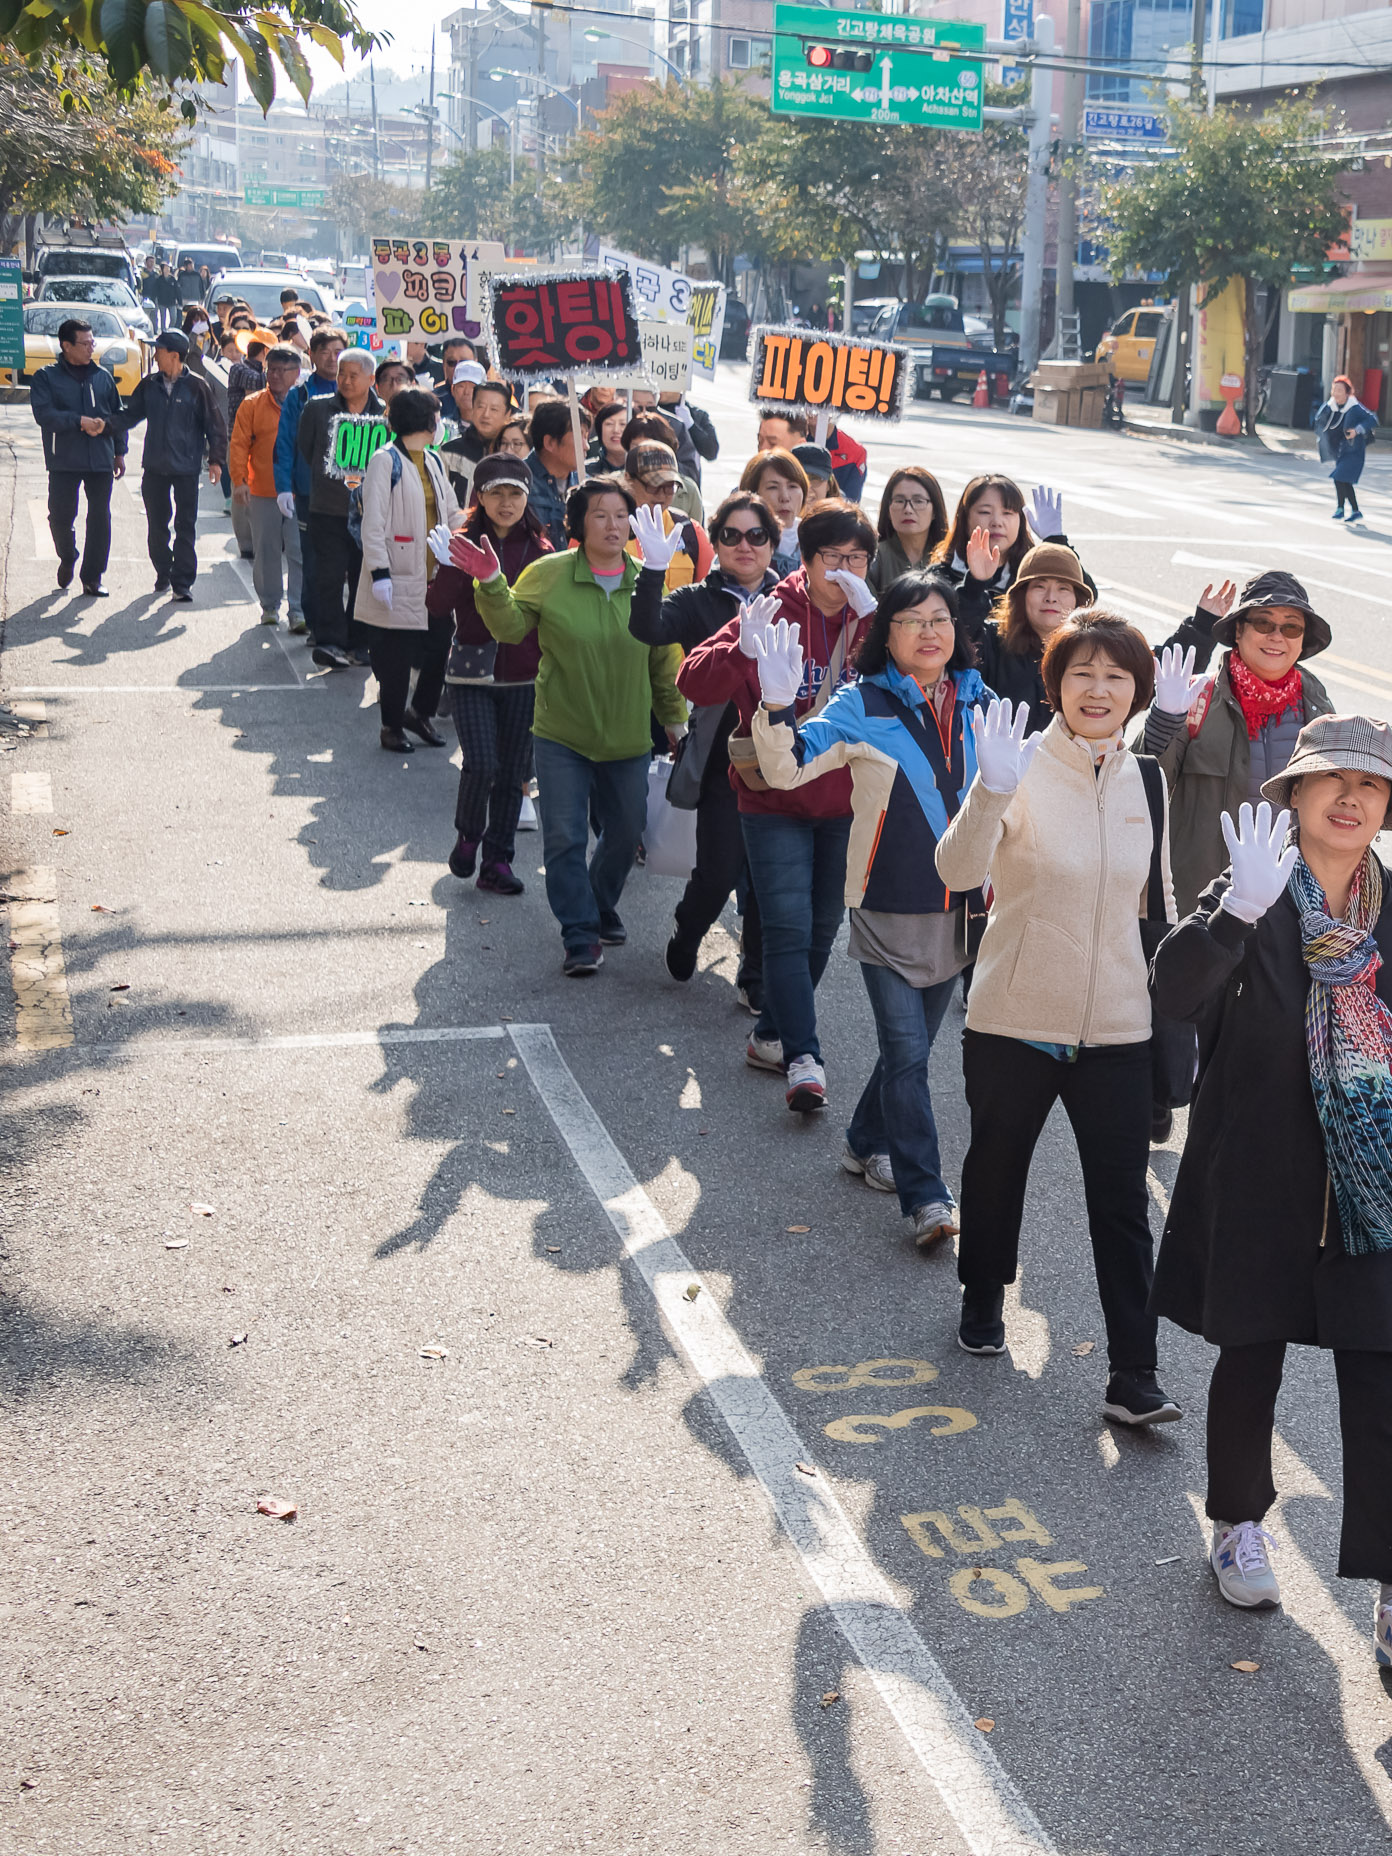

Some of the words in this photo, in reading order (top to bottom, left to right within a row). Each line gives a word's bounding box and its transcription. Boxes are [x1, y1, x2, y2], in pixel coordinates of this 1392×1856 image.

[837, 18, 936, 44] 긴고랑체육공원
[778, 70, 851, 94] 용곡삼거리
[778, 88, 816, 105] Yonggok
[921, 85, 978, 106] 아차산역
[871, 108, 900, 121] 200m
[922, 102, 960, 117] Achasan
[962, 107, 978, 118] Stn
[373, 239, 450, 267] 중곡3동
[501, 280, 625, 365] 홧팅!
[757, 336, 896, 413] 파이팅!
[791, 1358, 978, 1444] 38
